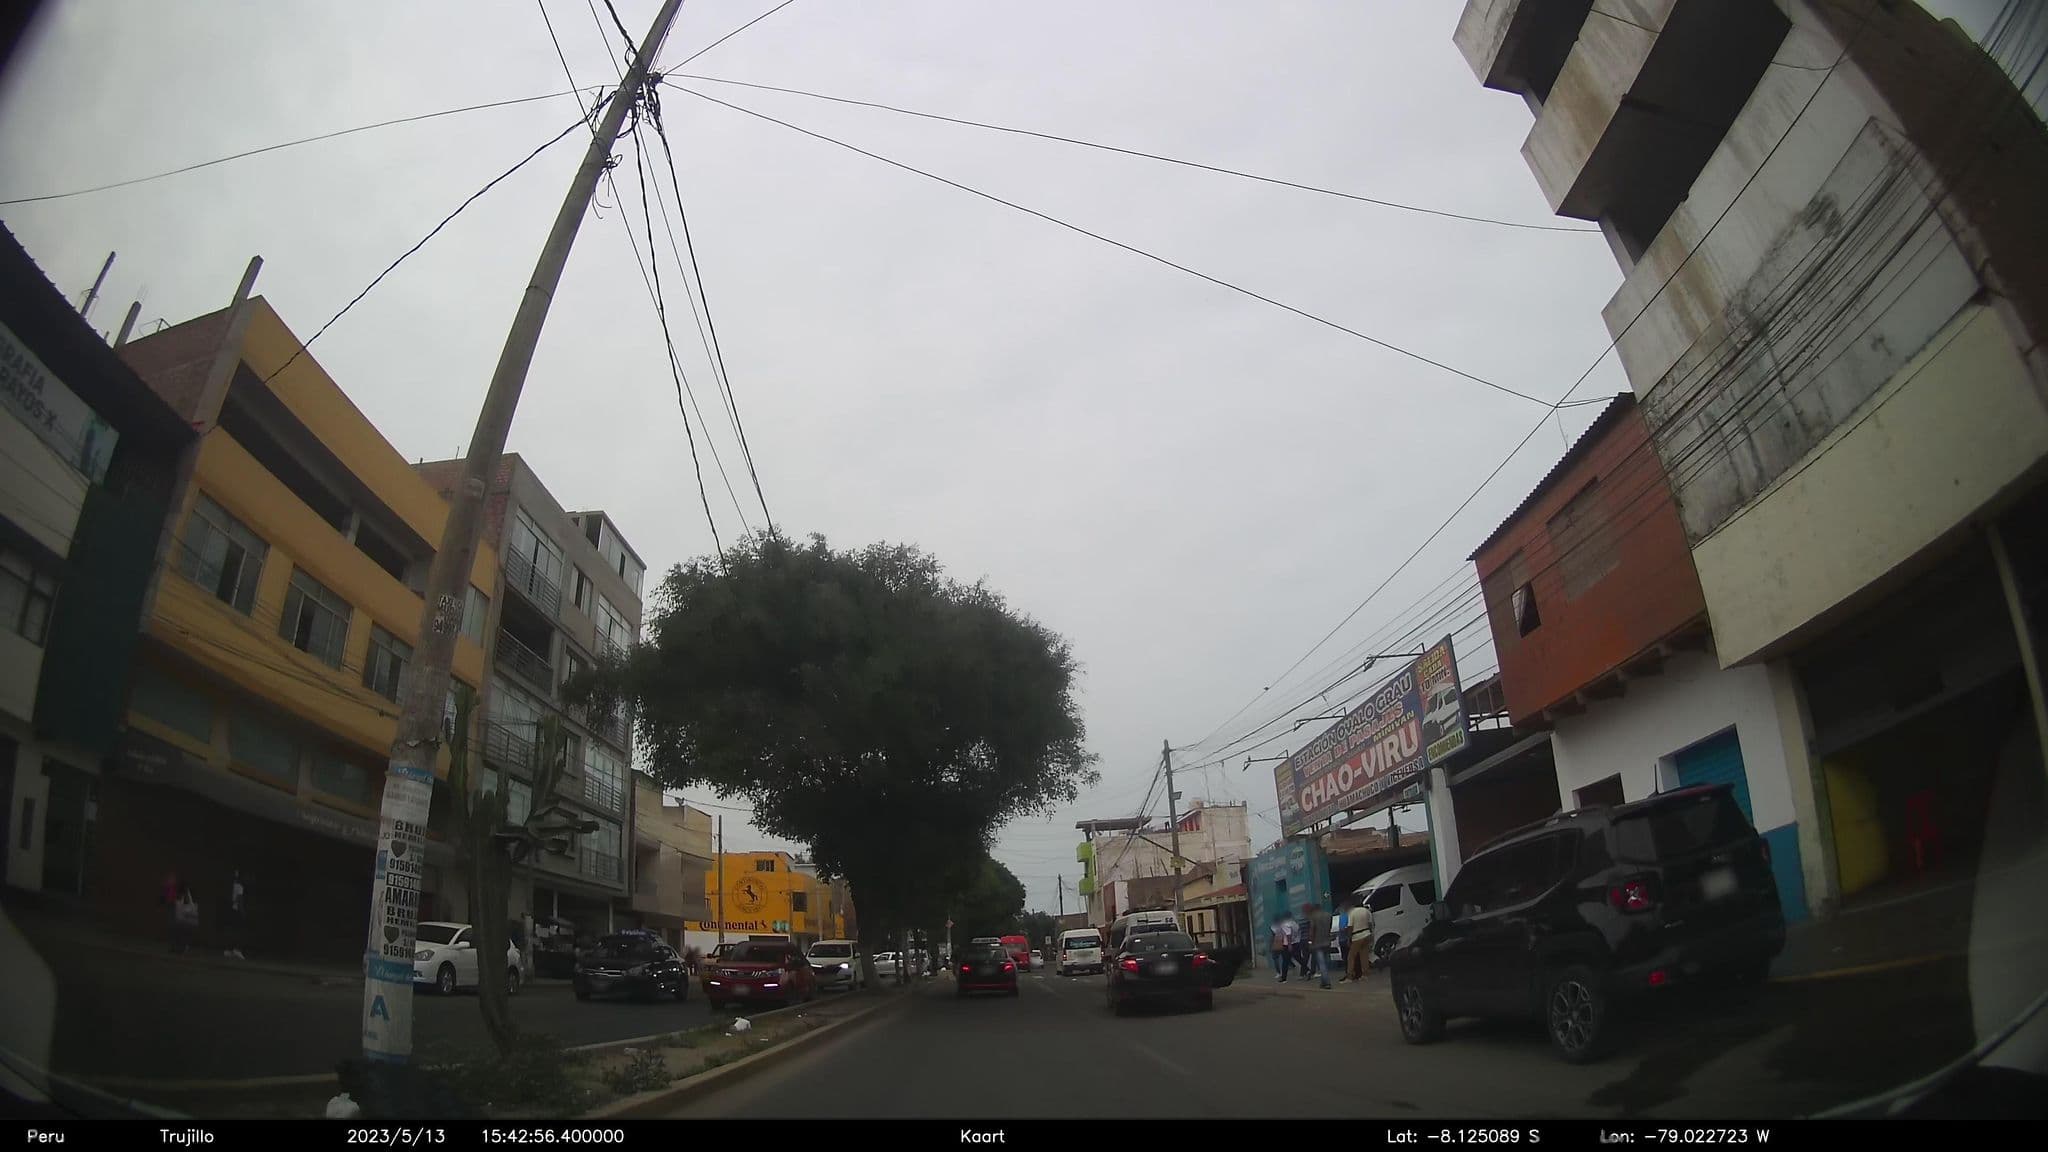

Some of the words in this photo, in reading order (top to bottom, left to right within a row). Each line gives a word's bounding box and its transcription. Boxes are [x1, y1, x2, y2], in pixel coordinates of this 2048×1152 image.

[1375, 671, 1414, 713] GRAU
[1334, 740, 1349, 760] DE
[1348, 701, 1404, 748] PASAJES
[1373, 710, 1415, 742] MINIVAN
[386, 906, 416, 920] BRU
[700, 919, 758, 931] Connental
